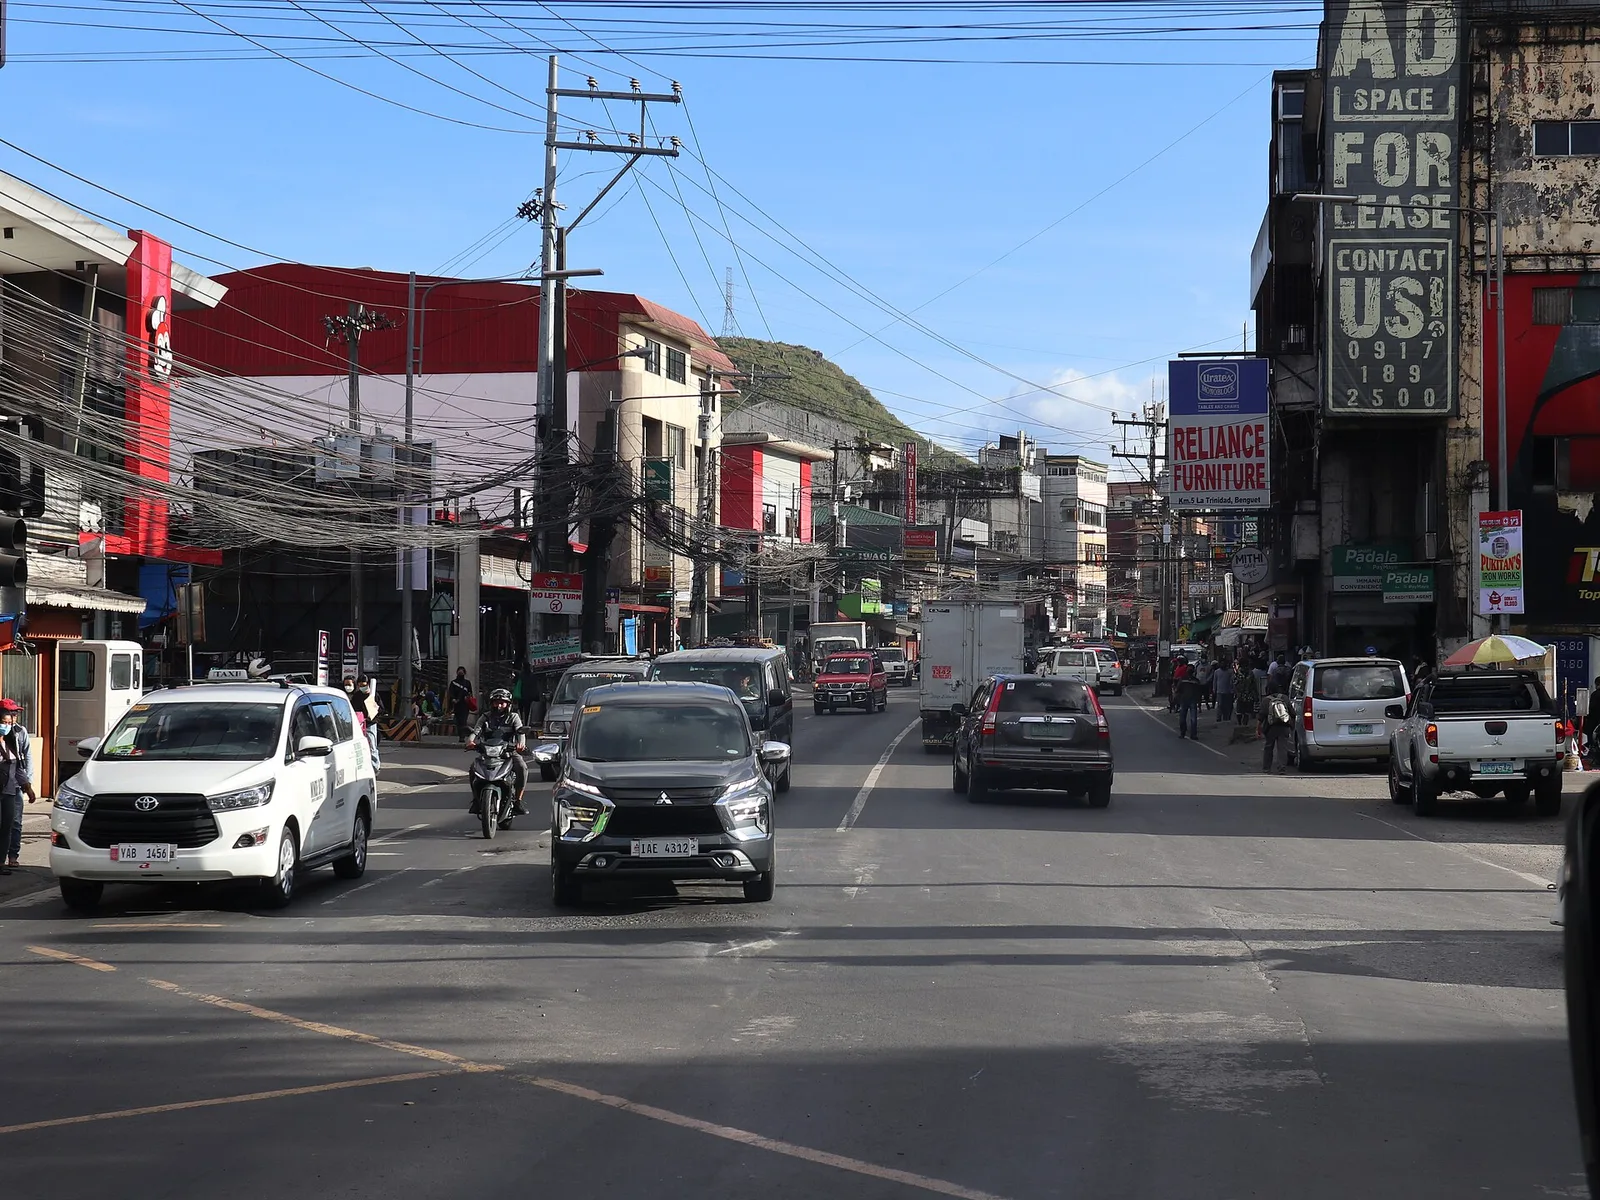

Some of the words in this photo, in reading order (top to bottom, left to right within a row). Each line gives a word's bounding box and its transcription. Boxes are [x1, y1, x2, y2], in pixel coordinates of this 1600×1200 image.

[1330, 0, 1457, 79] AD
[1353, 87, 1434, 112] SPACE
[1333, 131, 1452, 188] FOR
[1333, 194, 1451, 230] LEASE
[1336, 248, 1446, 272] CONTACT
[1338, 275, 1446, 340] US!
[1173, 424, 1265, 461] RELIANCE
[1174, 462, 1266, 491] FURNITURE
[1234, 497, 1261, 505] Benguet
[1236, 554, 1263, 564] MITHI
[1345, 550, 1398, 563] Padala
[1480, 553, 1521, 571] PUKITAN'S
[1386, 572, 1429, 584] Padala
[1482, 572, 1497, 580] IRON
[1498, 572, 1520, 580] WORKS
[120, 848, 137, 858] YAB
[146, 848, 167, 858] 1456
[641, 844, 658, 854] IAE
[664, 843, 688, 854] 4312
